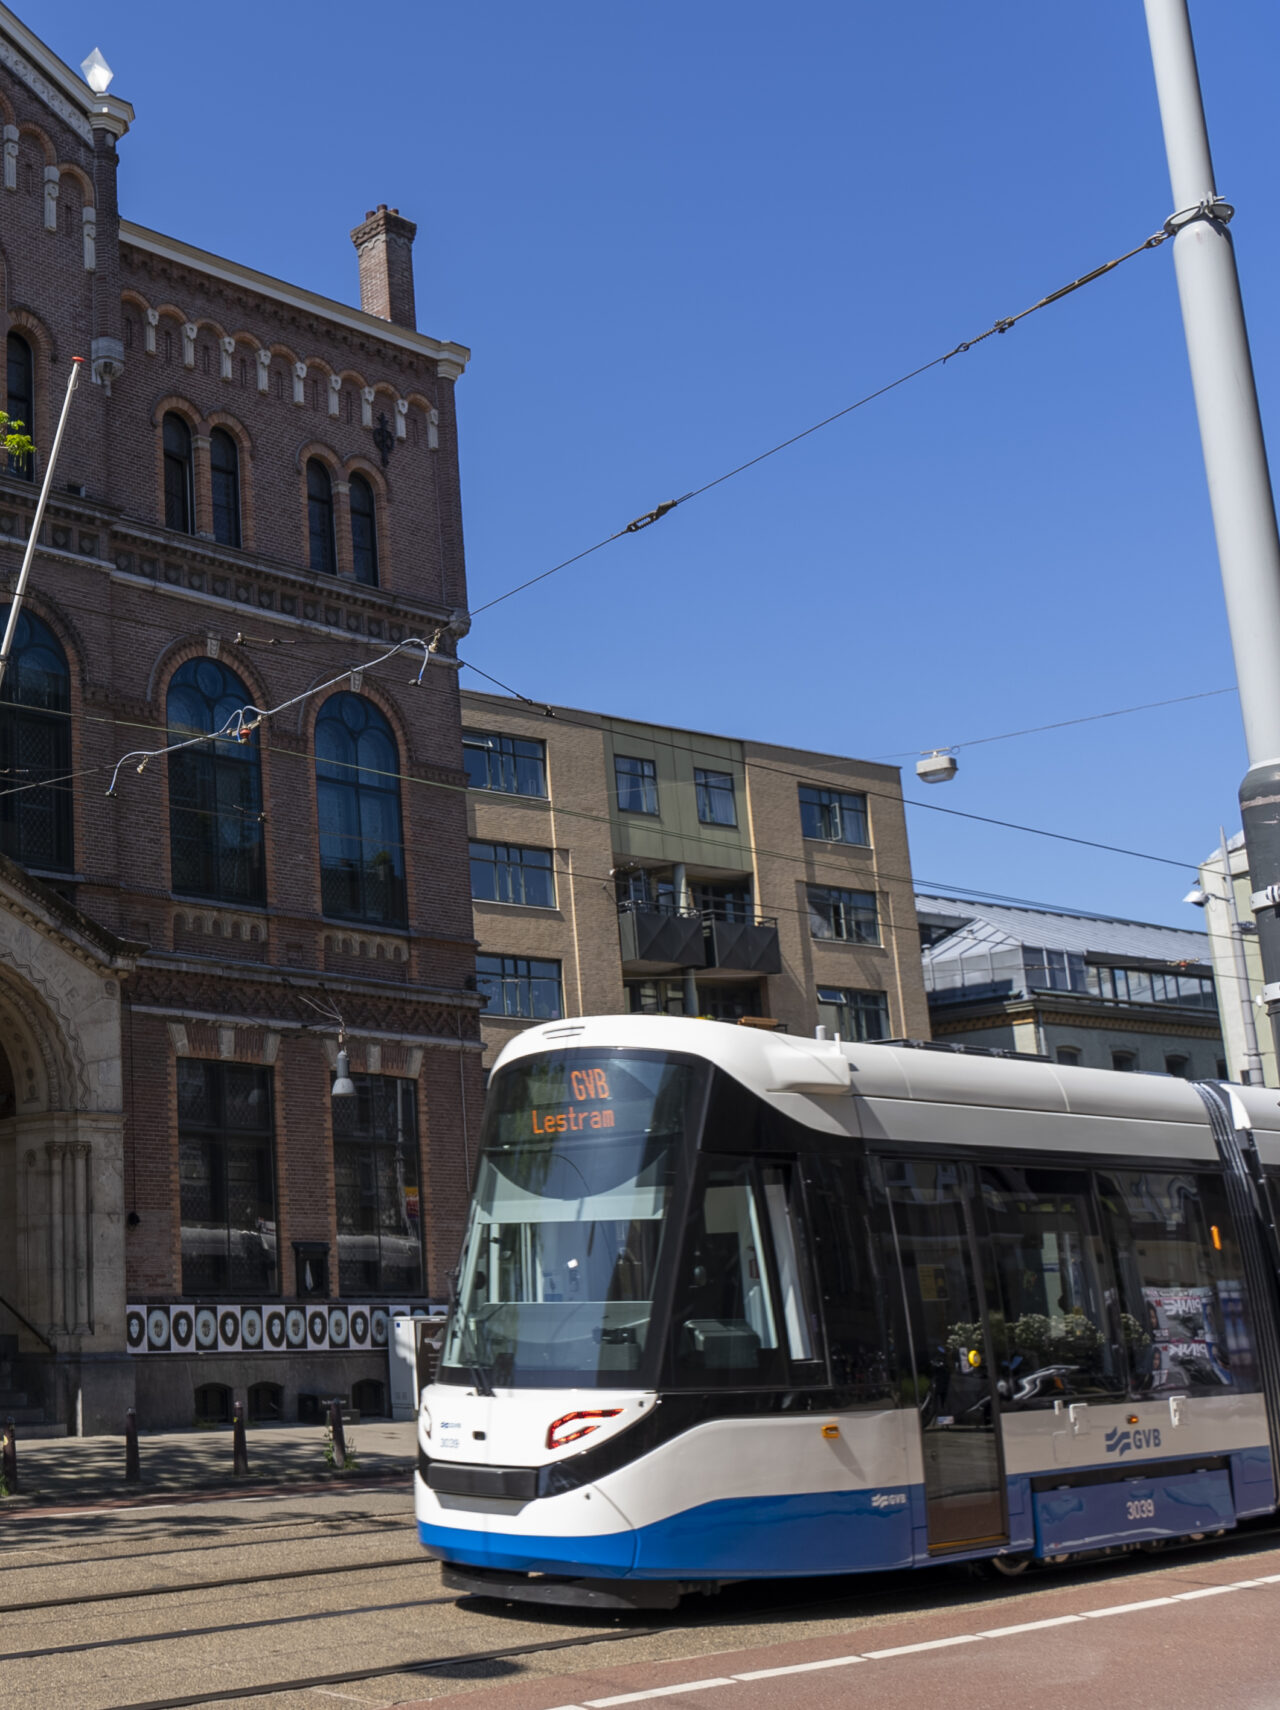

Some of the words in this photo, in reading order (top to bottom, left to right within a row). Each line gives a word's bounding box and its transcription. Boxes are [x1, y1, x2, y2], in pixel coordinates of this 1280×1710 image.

[571, 1068, 610, 1101] GVB
[532, 1106, 615, 1134] Lestram
[1133, 1428, 1162, 1449] GVB
[1126, 1499, 1154, 1519] 3039
